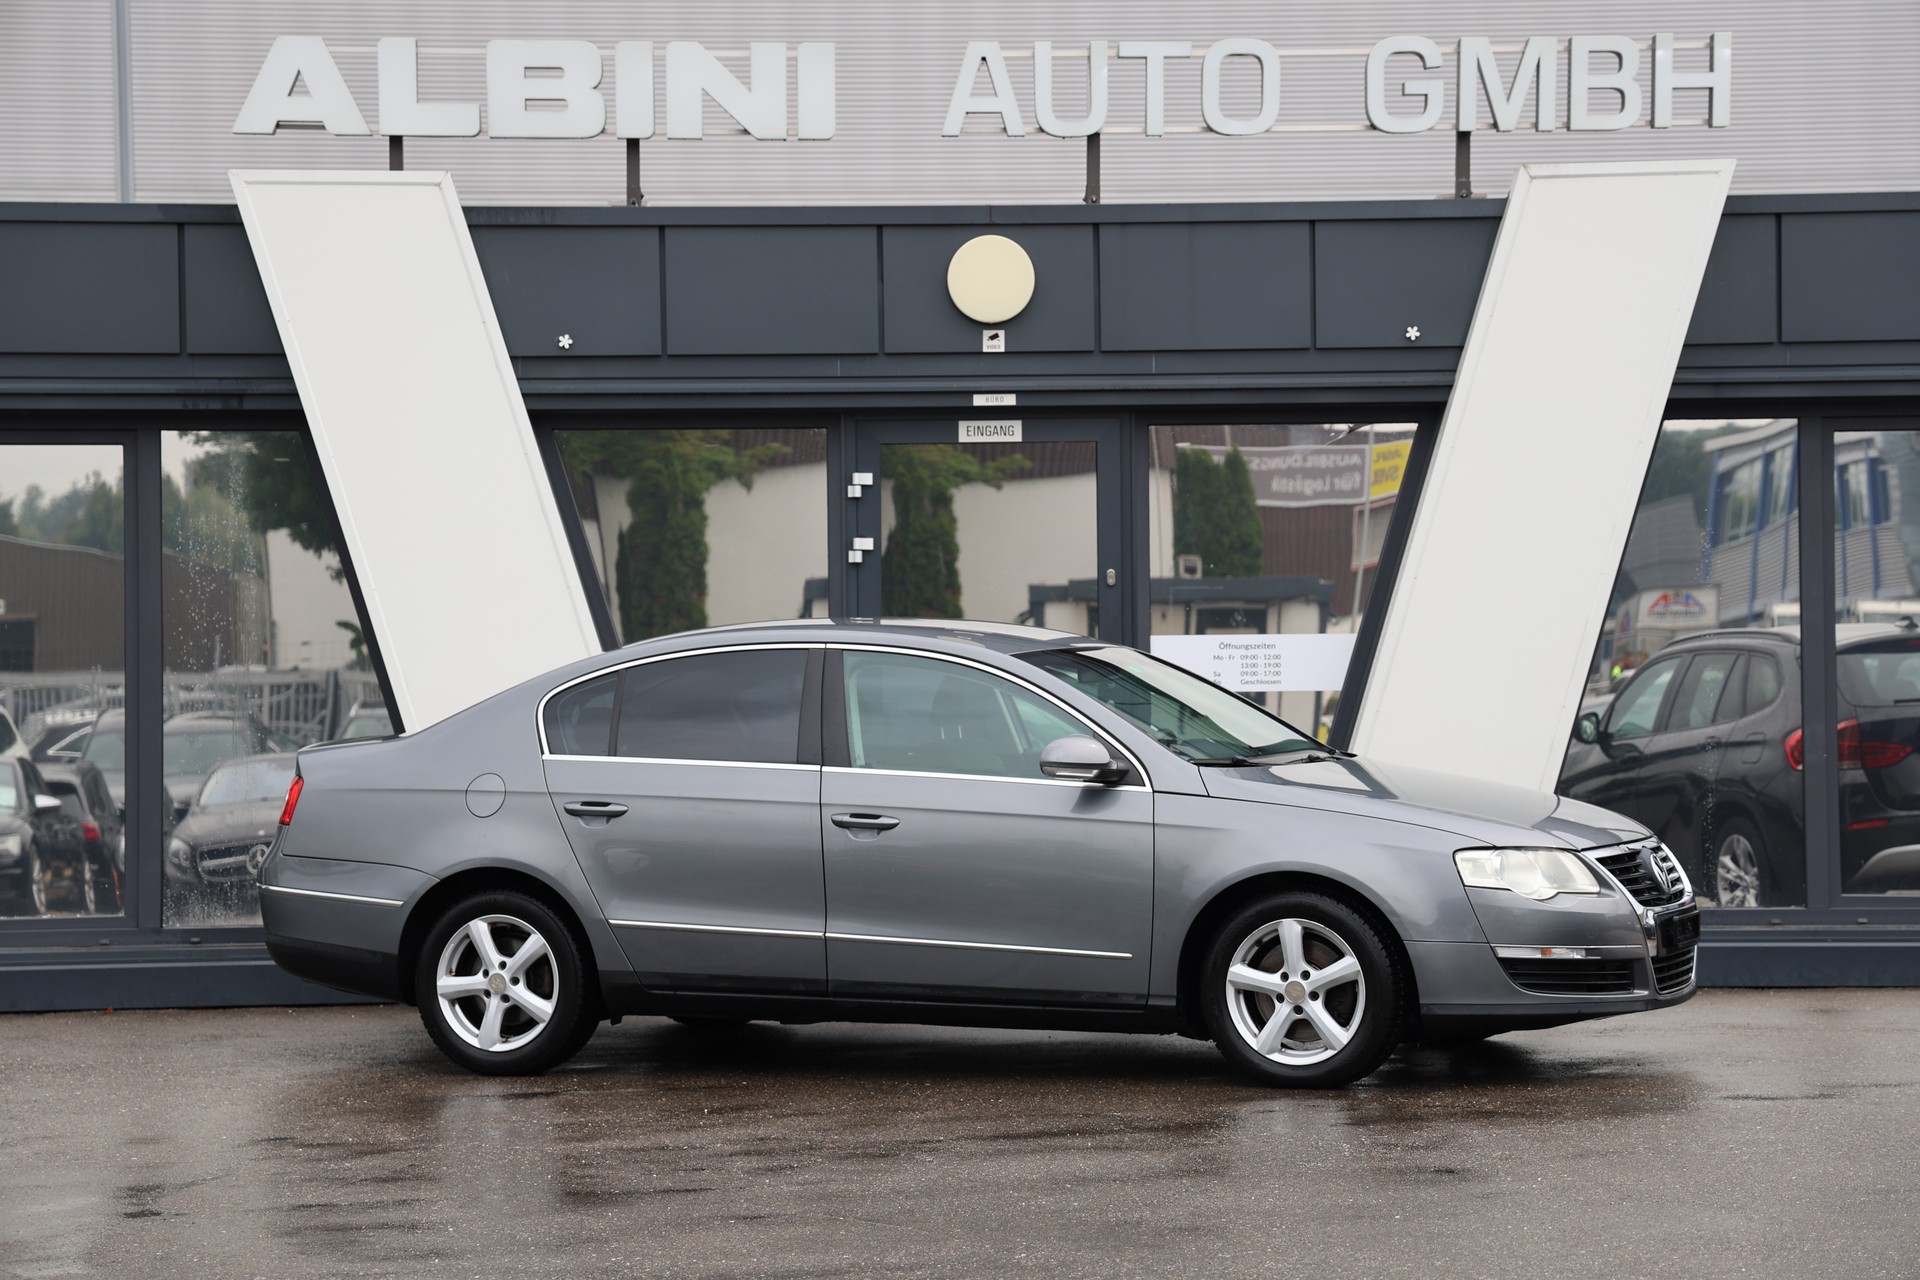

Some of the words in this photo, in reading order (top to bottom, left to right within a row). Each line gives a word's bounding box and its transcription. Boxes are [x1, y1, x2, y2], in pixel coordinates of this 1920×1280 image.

[232, 36, 836, 140] ALBINI
[941, 37, 1282, 137] AUTO
[1365, 31, 1733, 134] GMBH
[966, 425, 1015, 437] EINGANG
[1218, 642, 1276, 651] Öffnungszeiten
